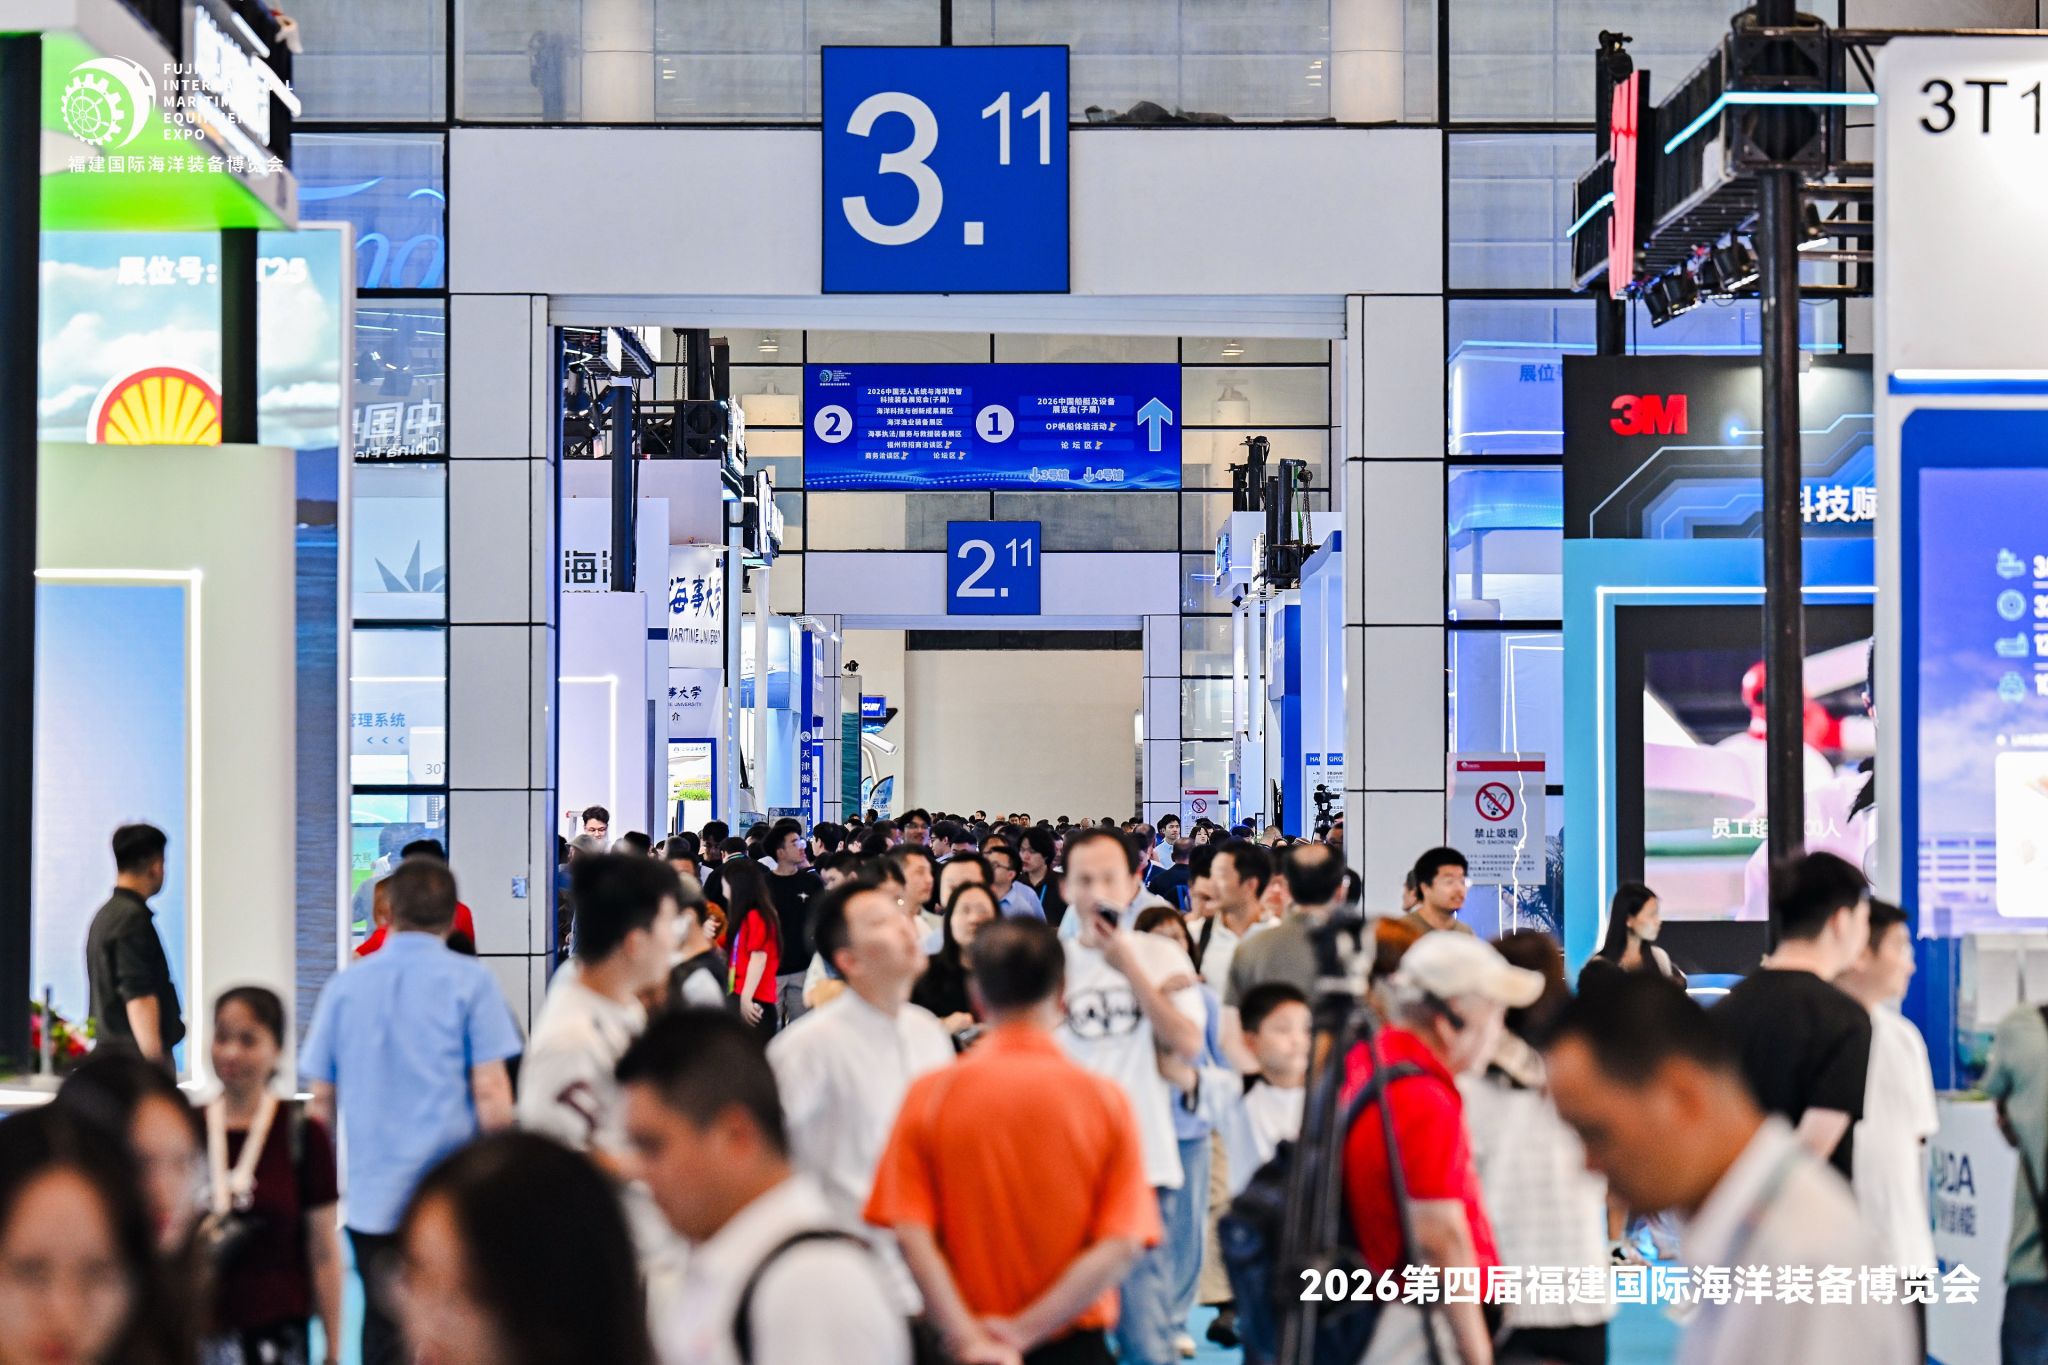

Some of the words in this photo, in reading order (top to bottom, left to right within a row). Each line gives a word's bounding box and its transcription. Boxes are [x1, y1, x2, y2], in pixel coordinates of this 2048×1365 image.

[825, 412, 842, 436] 2
[987, 412, 1003, 436] 1
[1609, 394, 1689, 436] 3M
[1474, 828, 1518, 839] 禁止吸烟
